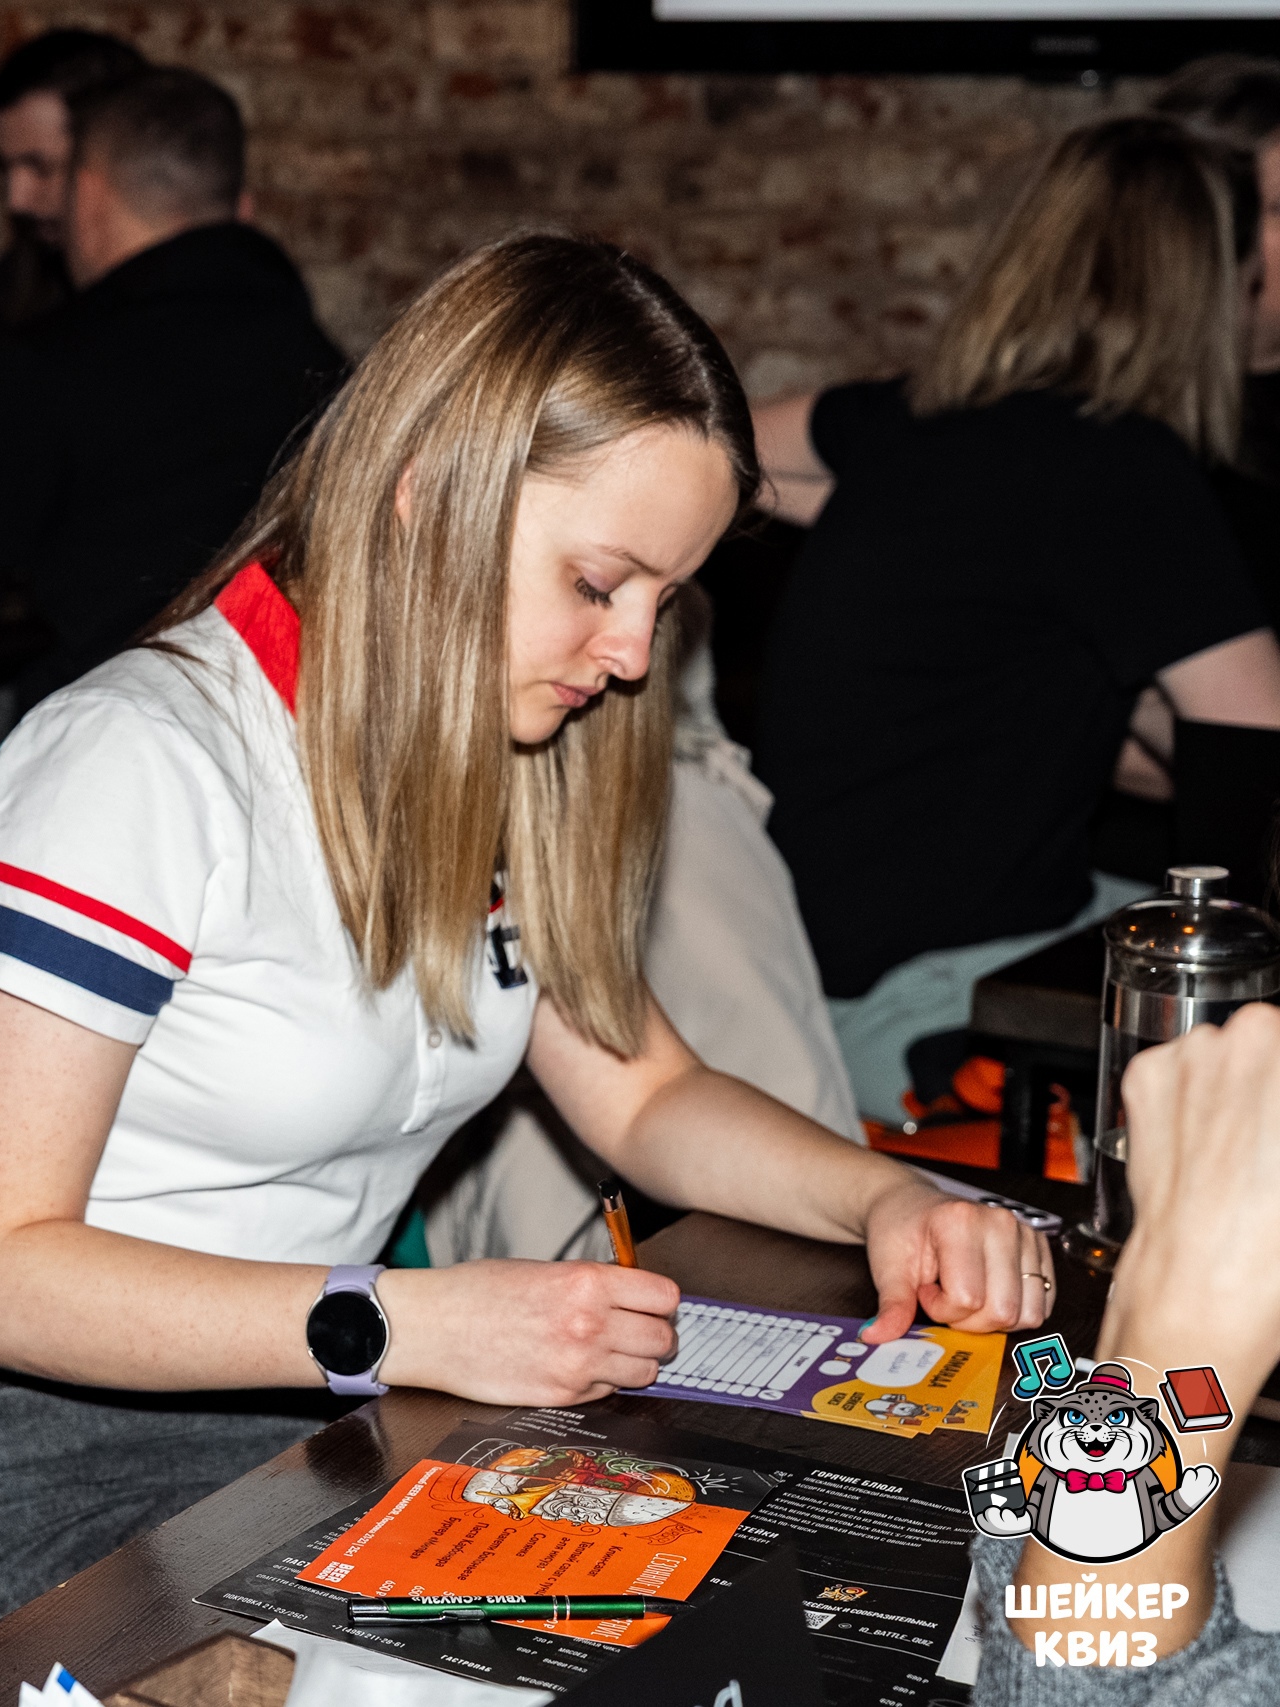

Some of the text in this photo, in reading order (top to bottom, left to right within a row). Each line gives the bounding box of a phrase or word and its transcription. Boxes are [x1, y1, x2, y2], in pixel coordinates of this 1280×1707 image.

[928, 1350, 973, 1388] КОМАНДА
[537, 1408, 585, 1420] ЗАКУСКИ
[795, 1483, 825, 1493] АССОРТИ
[825, 1489, 861, 1500] КОЛБАСОК
[811, 1469, 903, 1494] ГОРЯЧИЕ БЛЮДА
[750, 1514, 777, 1524] РУЛЬКА
[774, 1497, 807, 1508] КУРИНЫЕ
[806, 1505, 834, 1515] ГРУДКИ
[840, 1513, 862, 1521] ПЕСТО
[872, 1520, 905, 1531] ВЯЛЕНЫХ
[906, 1527, 938, 1536] ТОМАТОВ
[782, 1492, 823, 1505] КЕСАДИЛЬЯ
[893, 1517, 923, 1526] СЫРАМИ
[788, 1508, 811, 1517] ВЕПРЯ
[825, 1517, 854, 1527] СОУСОМ
[853, 1523, 871, 1531] JACK
[435, 1516, 462, 1537] Бургер
[758, 1508, 801, 1523] МЕДАЛЬОНЫ
[848, 1530, 880, 1541] ВЫРЕЗКИ
[886, 1538, 922, 1548] ОВОЩАМИ
[435, 1521, 490, 1568] Паста Карбонара
[515, 1532, 547, 1557] Солянка
[324, 1563, 355, 1583] BEER
[710, 1577, 721, 1585] IQ
[256, 1573, 288, 1586] СПАГЕТТИ
[294, 1582, 329, 1598] ГОВЯЖЬЕЙ
[379, 1580, 397, 1593] 650
[223, 1593, 262, 1607] ПОКРОВКА
[850, 1608, 939, 1629] СООБРАЗИТЕЛЬНЫХ
[342, 1625, 364, 1638] (495)
[365, 1631, 406, 1648] 211-28-61
[858, 1626, 934, 1647] IQ_BATTLE_QUIZ
[441, 1654, 493, 1673] ГАСТРОПАБ
[557, 1647, 588, 1659] МЯСОЕД
